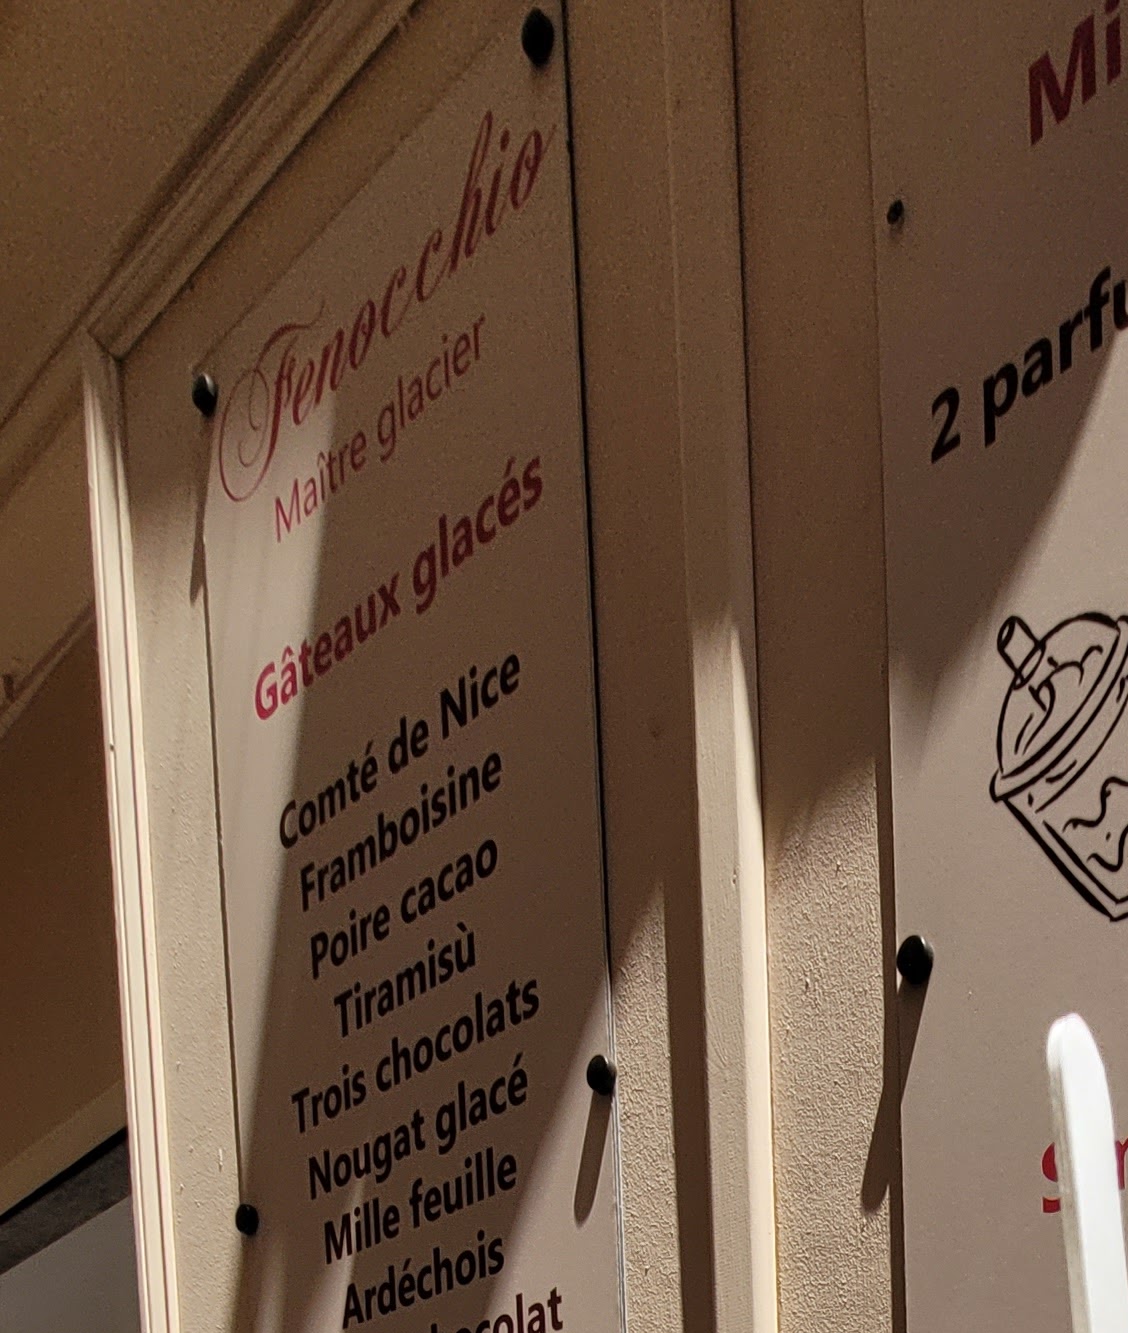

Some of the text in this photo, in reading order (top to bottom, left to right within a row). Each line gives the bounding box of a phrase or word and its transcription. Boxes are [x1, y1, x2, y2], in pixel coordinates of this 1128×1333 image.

[218, 109, 557, 502] Fenocchio
[274, 313, 486, 543] Maître glacier
[931, 386, 960, 464] 2
[254, 456, 544, 721] Gâteaux glacés
[279, 654, 520, 849] Comté de Nice
[301, 751, 502, 912] Framboisine
[310, 839, 498, 980] Poire cacao
[333, 922, 476, 1037] Tiramisù
[291, 979, 540, 1134] Trois chocolats
[308, 1052, 528, 1200] Nougat glacé
[323, 1150, 517, 1265] Mille feuille
[342, 1229, 504, 1330] Ardéchois
